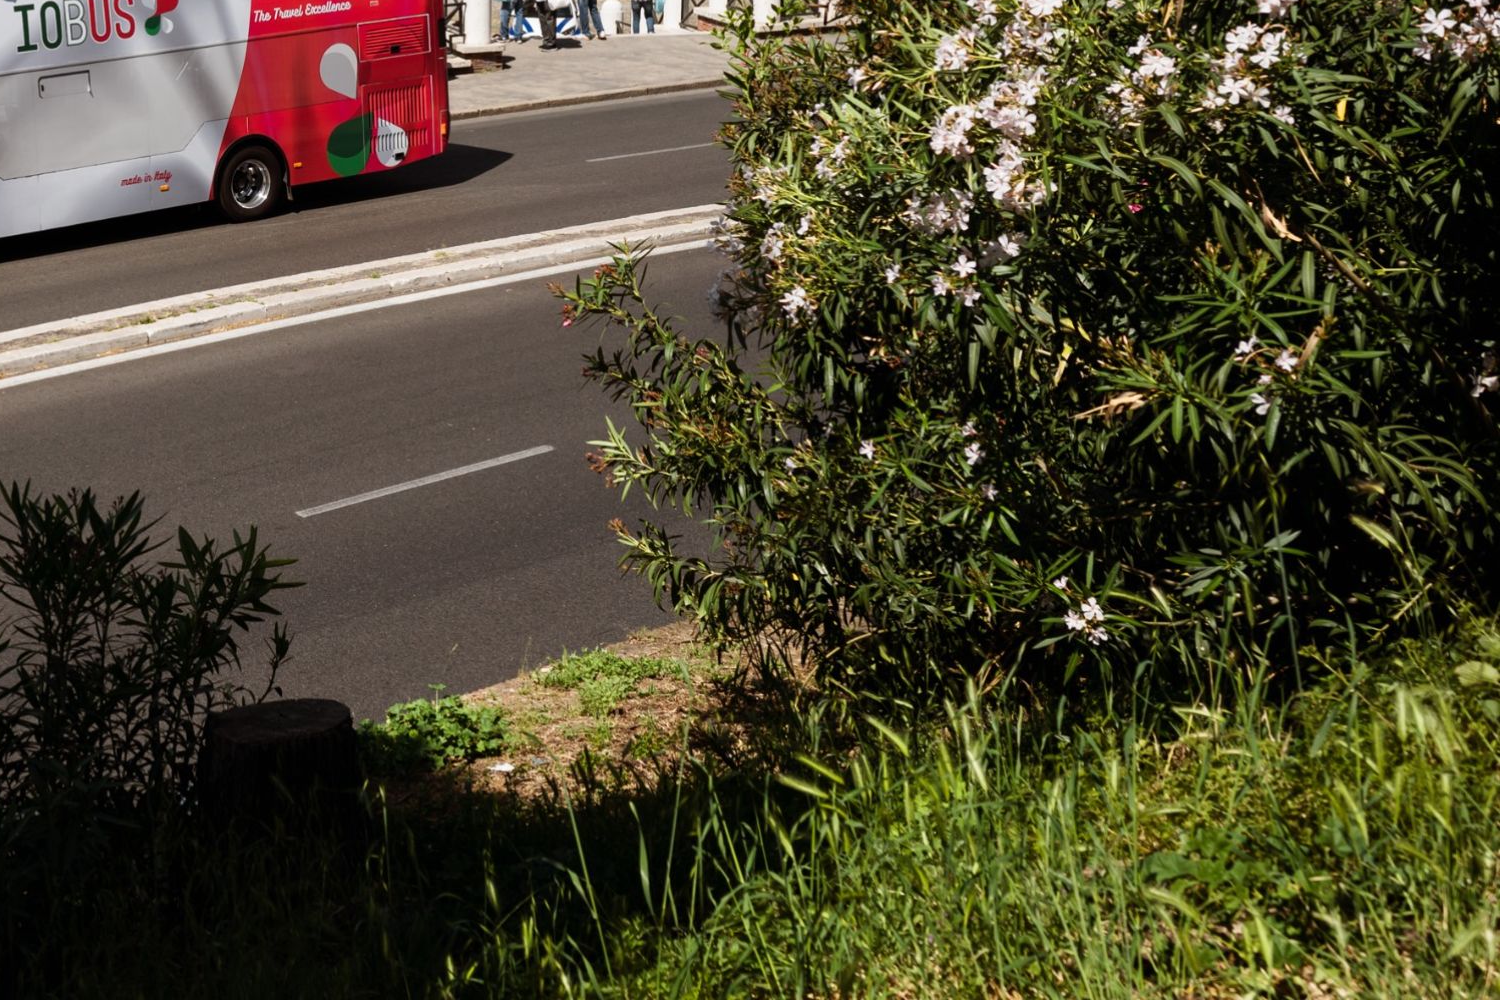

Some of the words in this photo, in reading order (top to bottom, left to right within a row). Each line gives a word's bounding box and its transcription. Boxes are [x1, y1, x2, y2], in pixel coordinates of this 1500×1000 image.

[253, 10, 271, 23] The
[273, 4, 303, 20] Travel
[305, 0, 352, 16] Excellence
[120, 174, 143, 187] made
[144, 172, 152, 183] in
[154, 169, 173, 183] Italy
